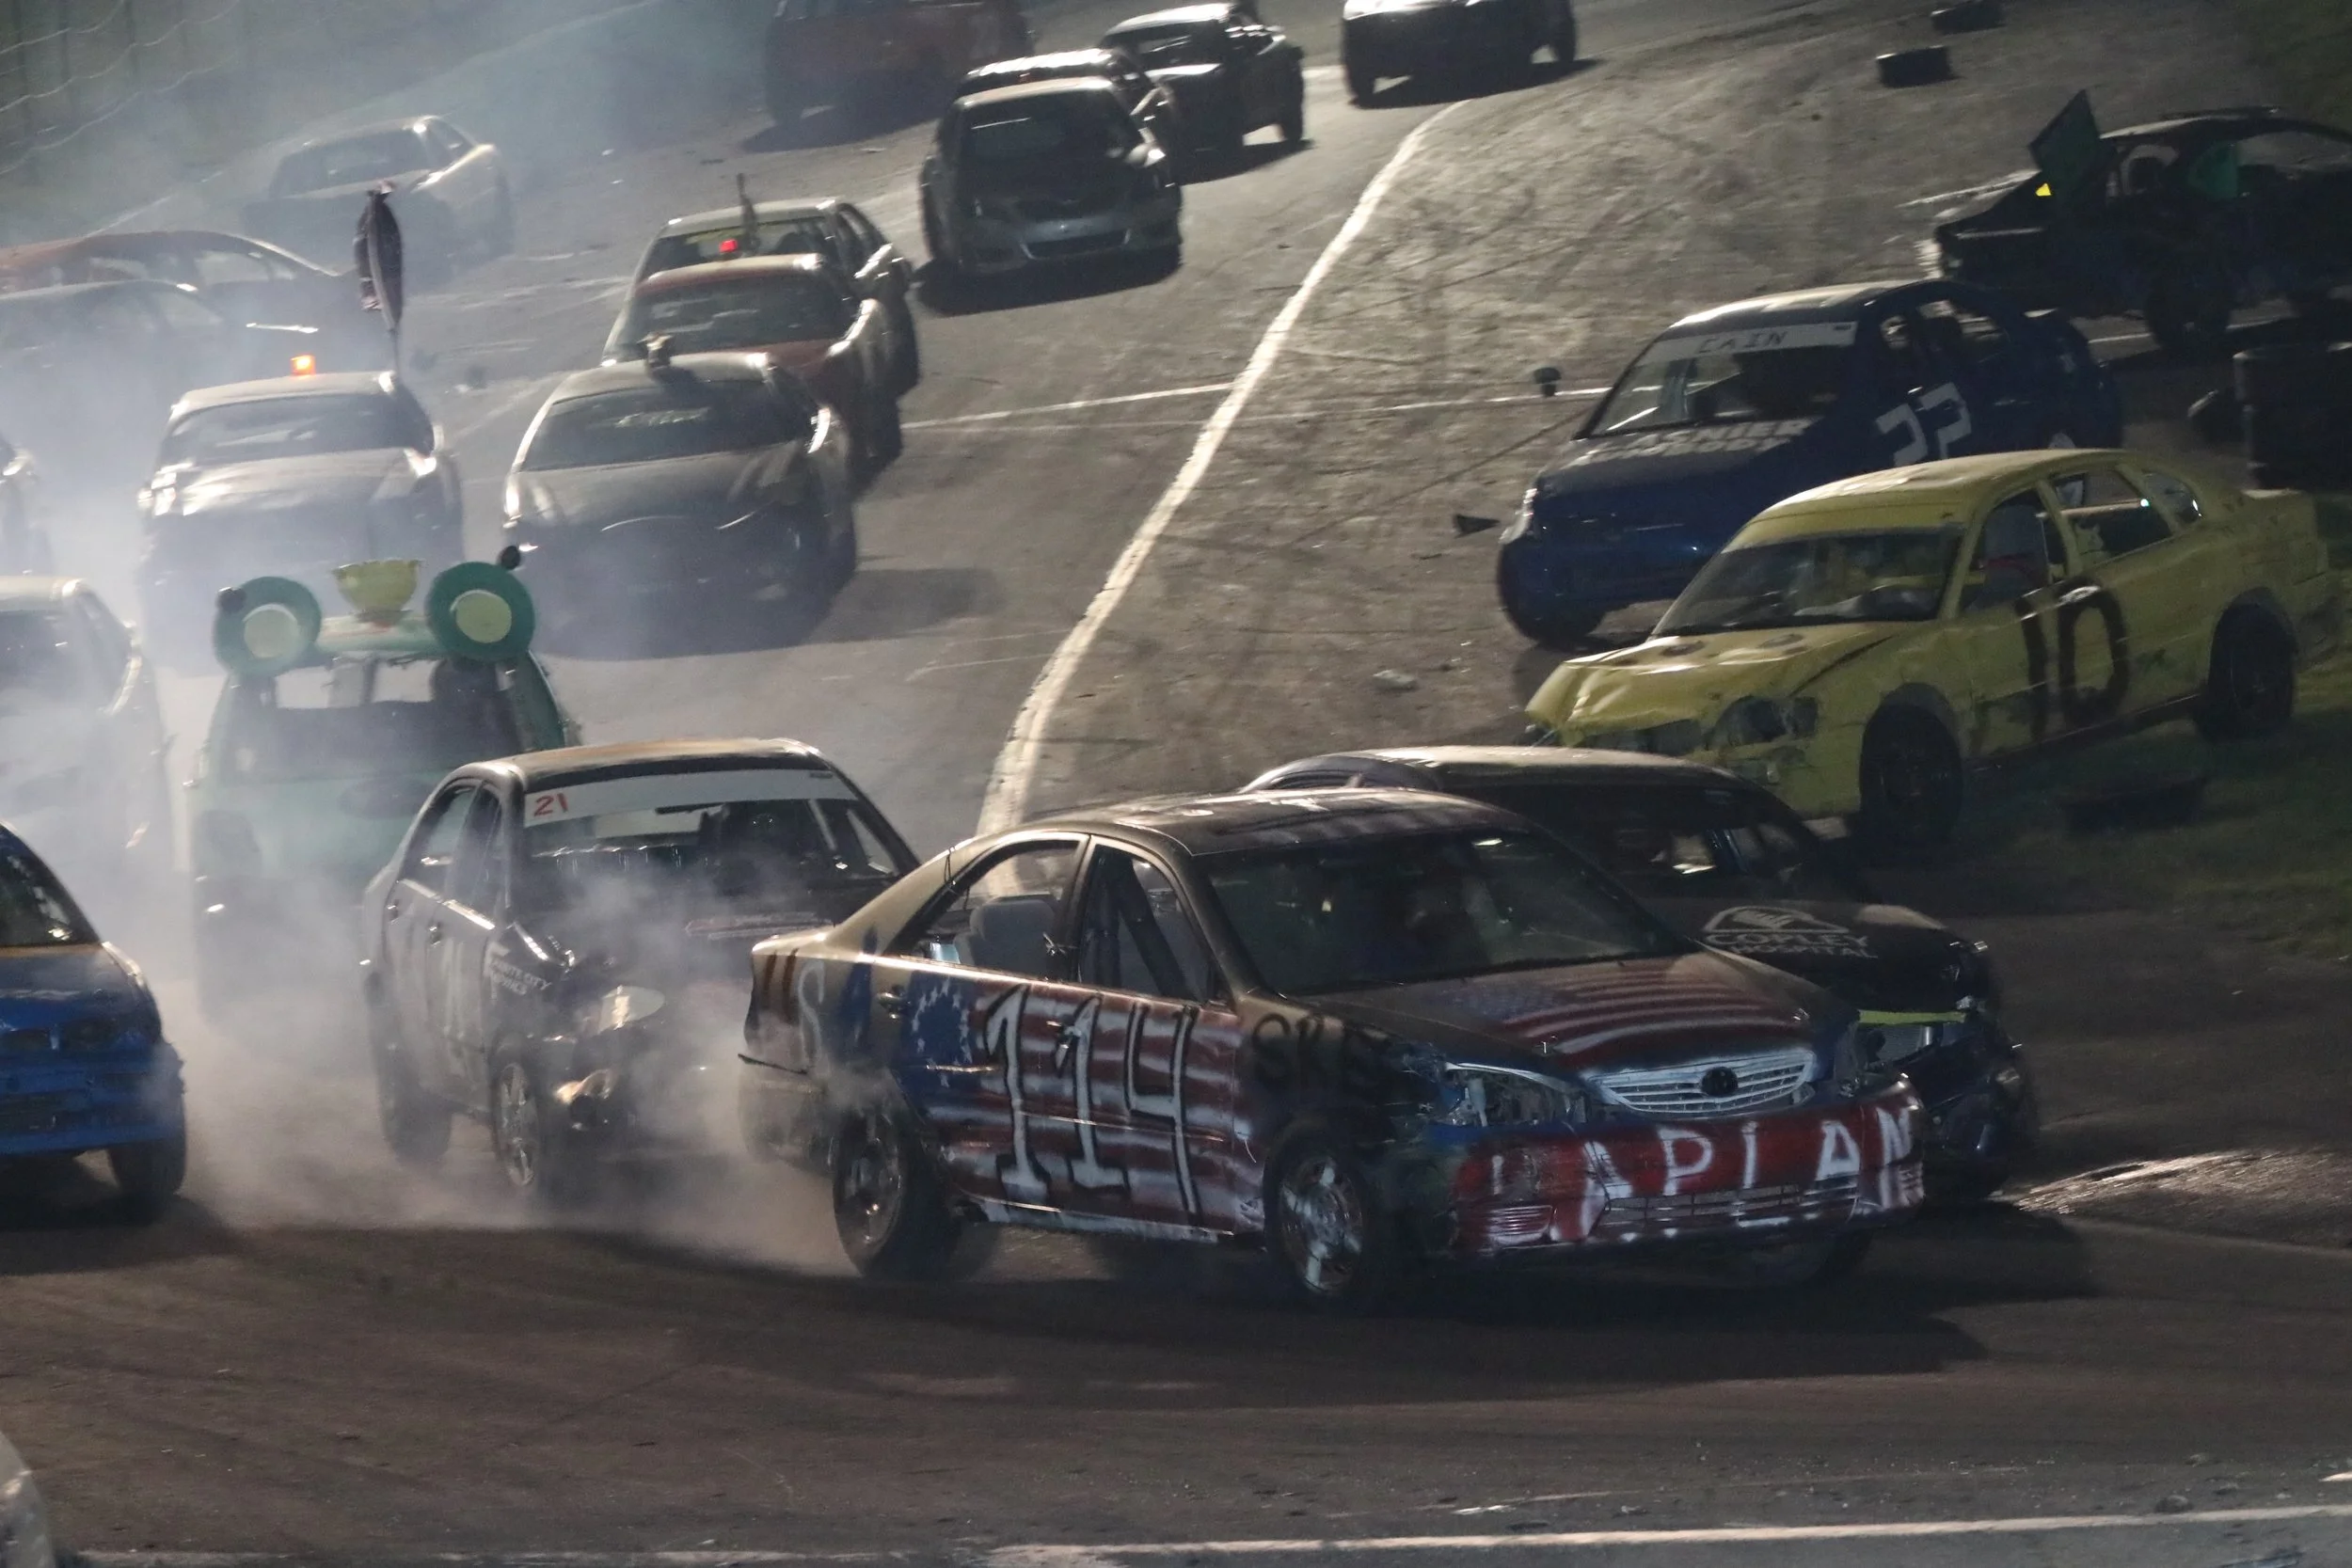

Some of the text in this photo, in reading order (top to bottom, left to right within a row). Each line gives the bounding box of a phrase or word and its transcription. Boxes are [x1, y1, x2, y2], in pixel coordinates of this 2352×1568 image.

[1693, 331, 1788, 355] CAIN
[532, 792, 569, 817] 21
[1706, 933, 1868, 947] COPLEY
[523, 973, 552, 990] CITY
[983, 983, 1200, 1224] 114
